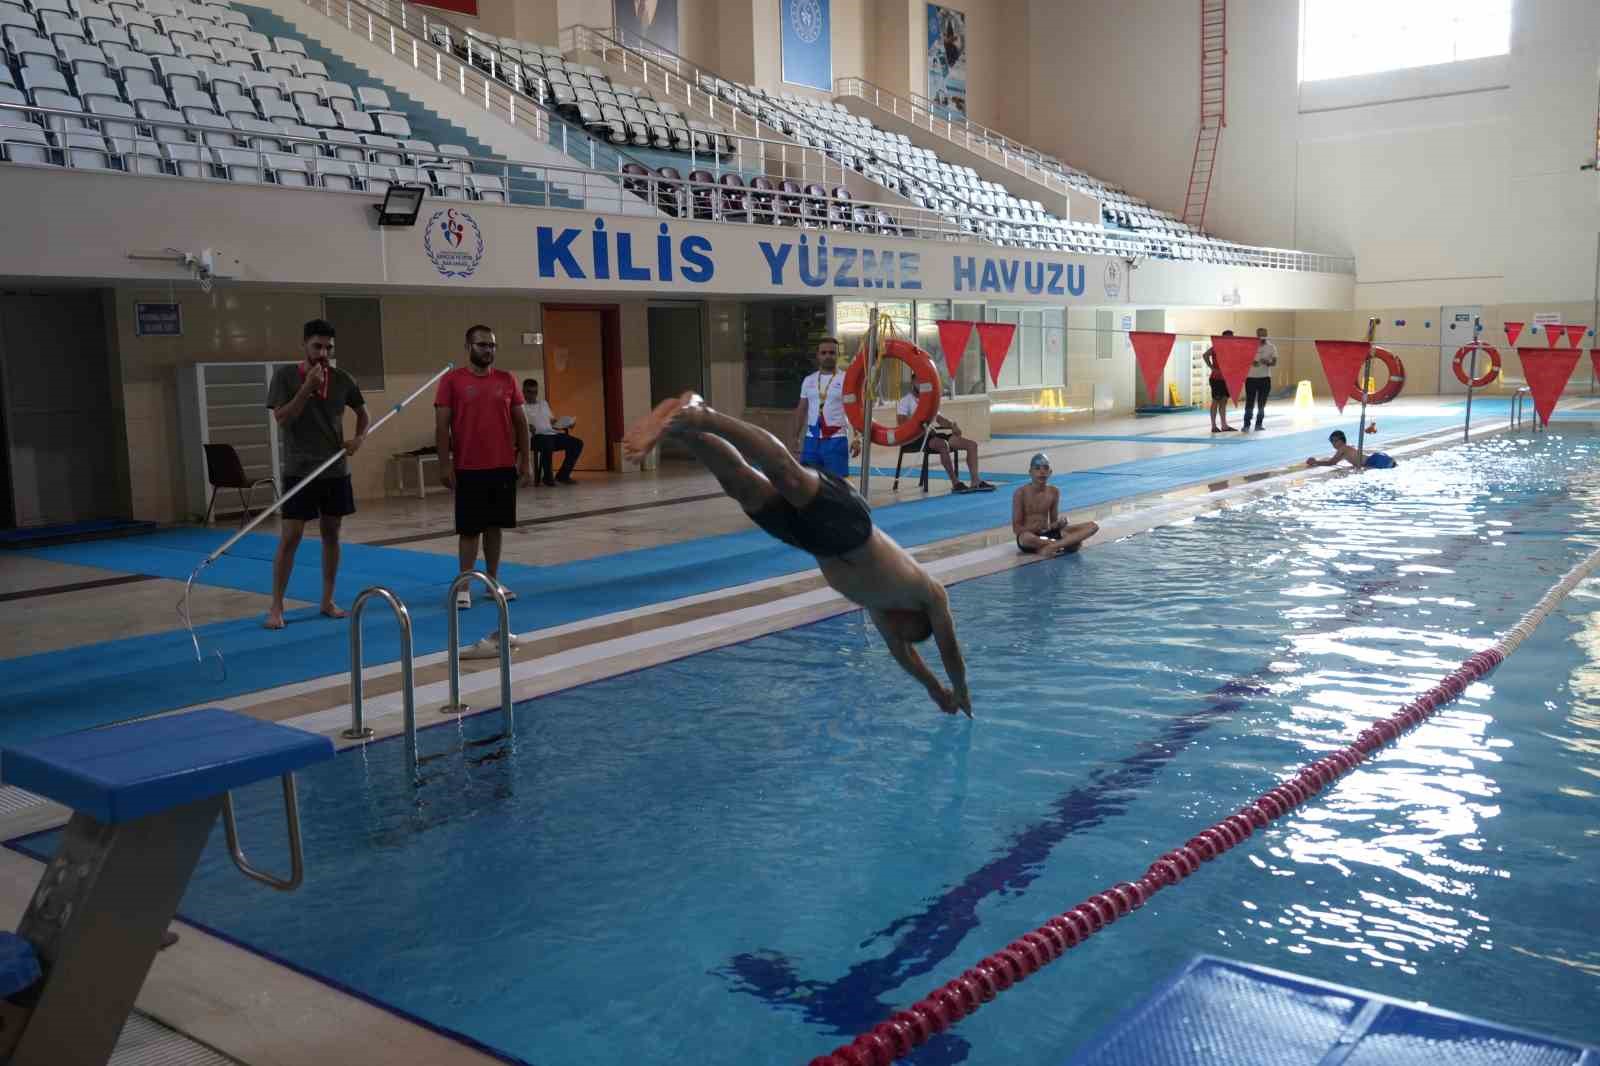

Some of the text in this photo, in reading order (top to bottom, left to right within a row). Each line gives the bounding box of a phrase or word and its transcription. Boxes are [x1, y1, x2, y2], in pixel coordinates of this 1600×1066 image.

[537, 217, 1085, 297] KİLİS YÜZME HAVUZU
